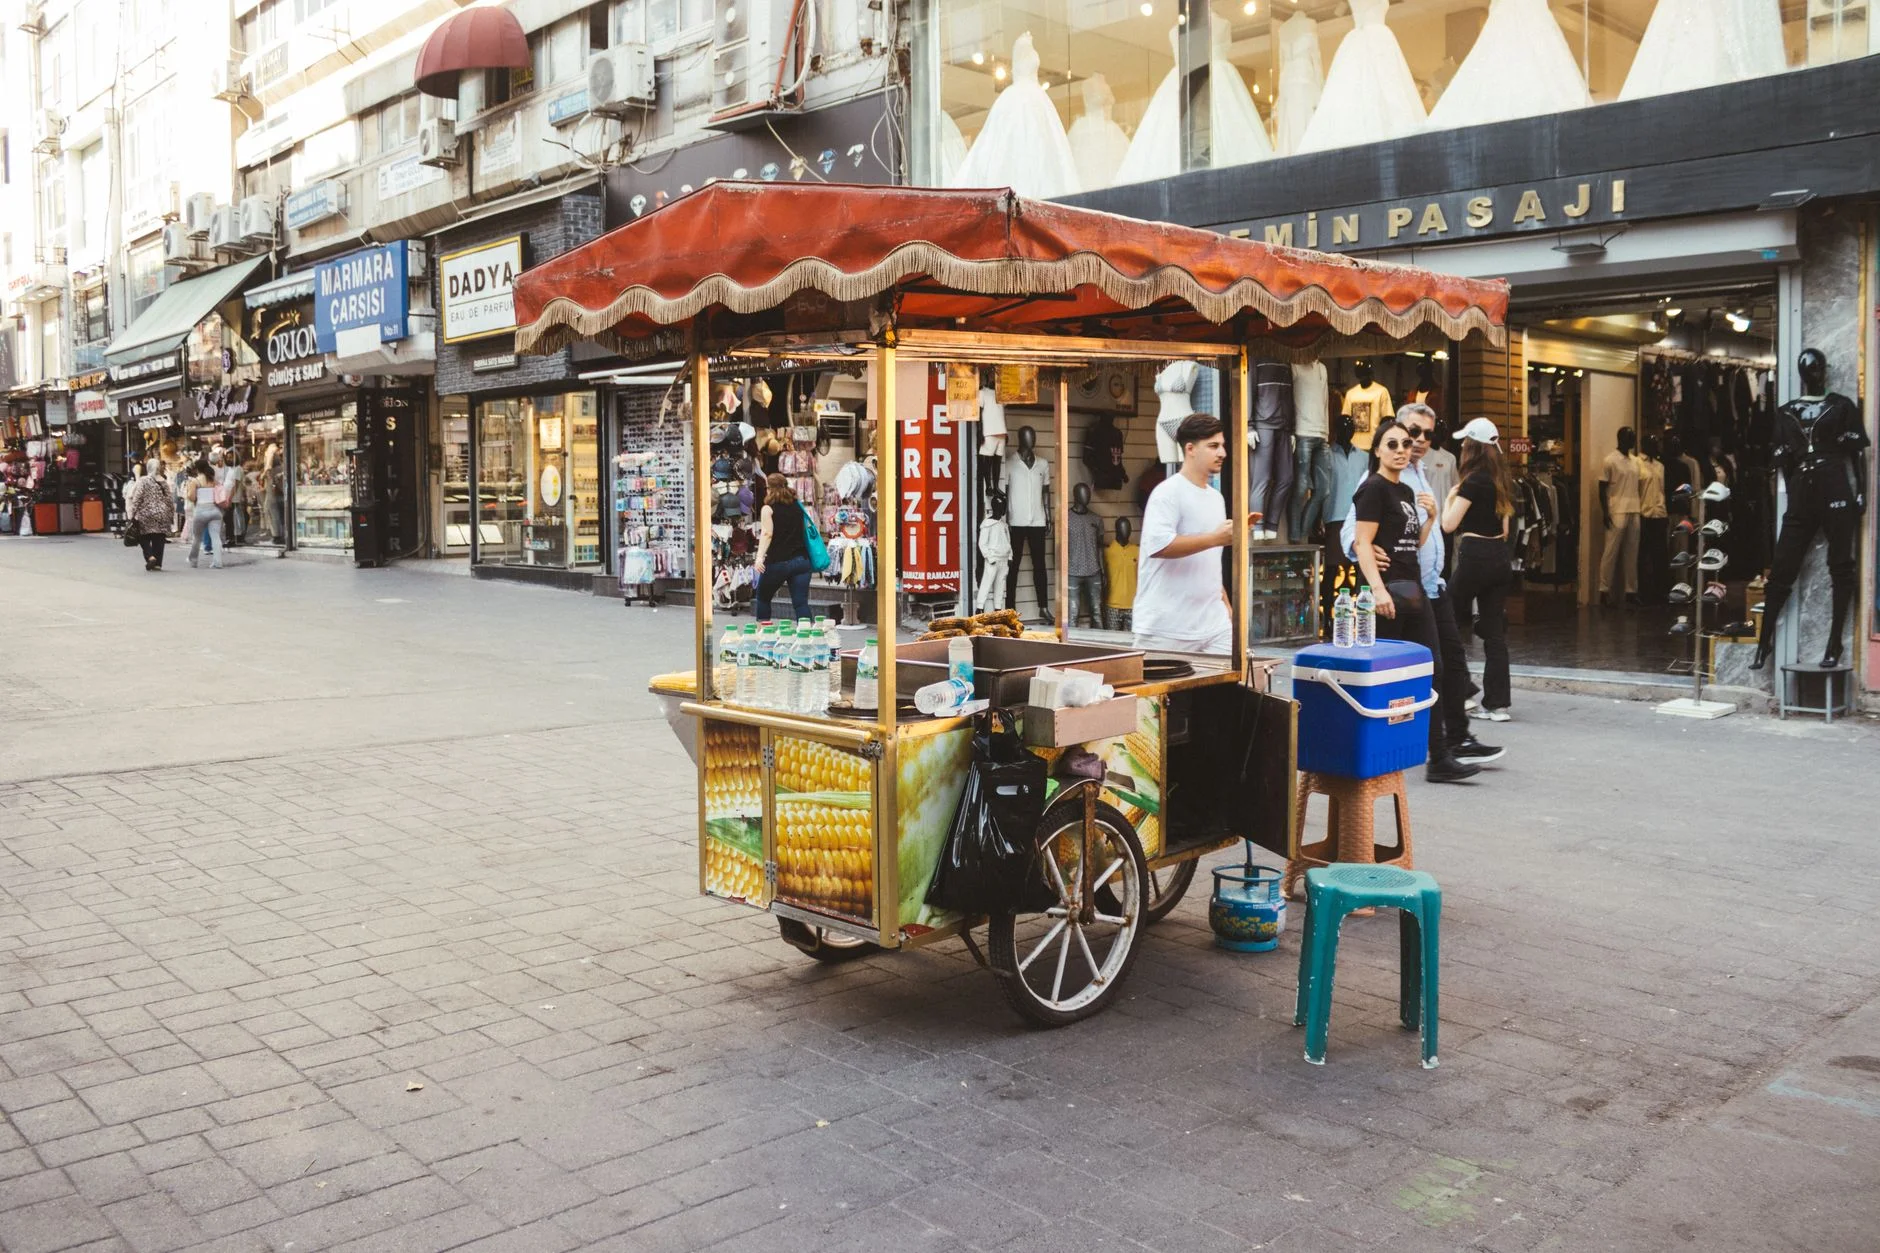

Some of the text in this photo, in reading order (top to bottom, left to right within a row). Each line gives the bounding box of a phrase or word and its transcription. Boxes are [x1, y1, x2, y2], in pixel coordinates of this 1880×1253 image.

[1229, 179, 1626, 248] MİN PASAJI
[320, 250, 394, 297] MARMARA
[449, 261, 513, 298] DADYA
[330, 287, 385, 332] ÇARŞISI
[450, 311, 465, 323] EAU
[469, 307, 479, 318] DE
[268, 362, 323, 387] GÜMÜŞ & SAAT
[932, 373, 954, 566] ERZİ
[926, 570, 960, 580] RAMAZAN
